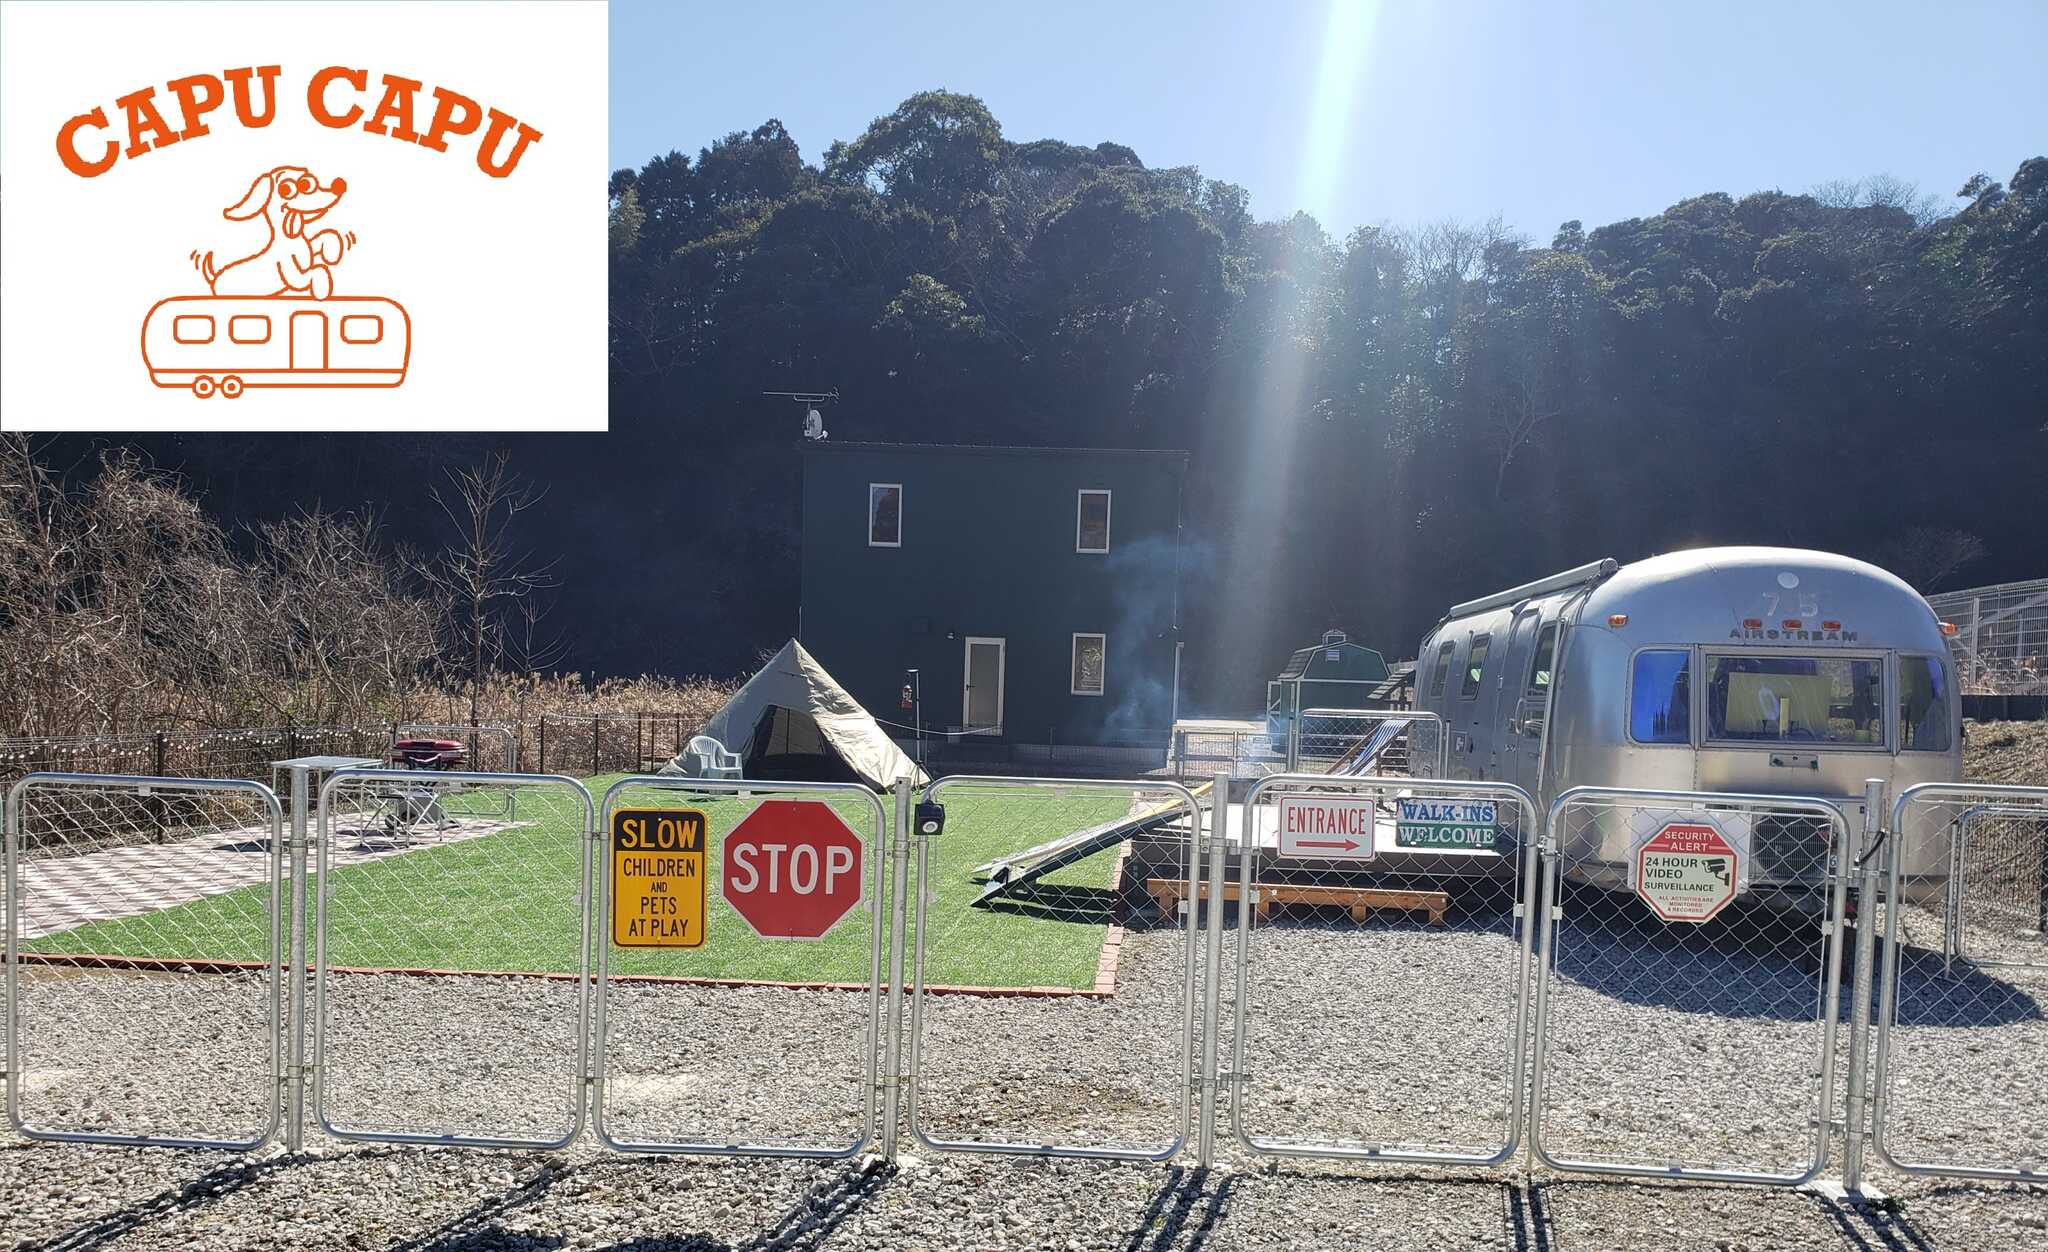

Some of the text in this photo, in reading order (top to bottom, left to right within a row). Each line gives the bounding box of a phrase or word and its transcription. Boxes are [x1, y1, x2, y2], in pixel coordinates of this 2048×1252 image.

[1729, 629, 1858, 642] AIRSTREAM
[1287, 806, 1367, 836] ENTRANCE
[1402, 803, 1494, 823] WALK-INS
[621, 819, 698, 849] SLOW
[1400, 826, 1495, 845] WELCOME
[1664, 831, 1715, 841] SECURITY
[1670, 842, 1709, 852] ALERT
[623, 858, 696, 878] CHILDREN
[731, 843, 854, 895] STOP
[1645, 857, 1698, 868] 24 HOUR
[1645, 868, 1683, 879] VIDEO
[650, 881, 668, 893] AND
[1644, 881, 1715, 893] SURVEILLANCE
[640, 896, 677, 915] PETS
[628, 919, 689, 938] AT PLAY
